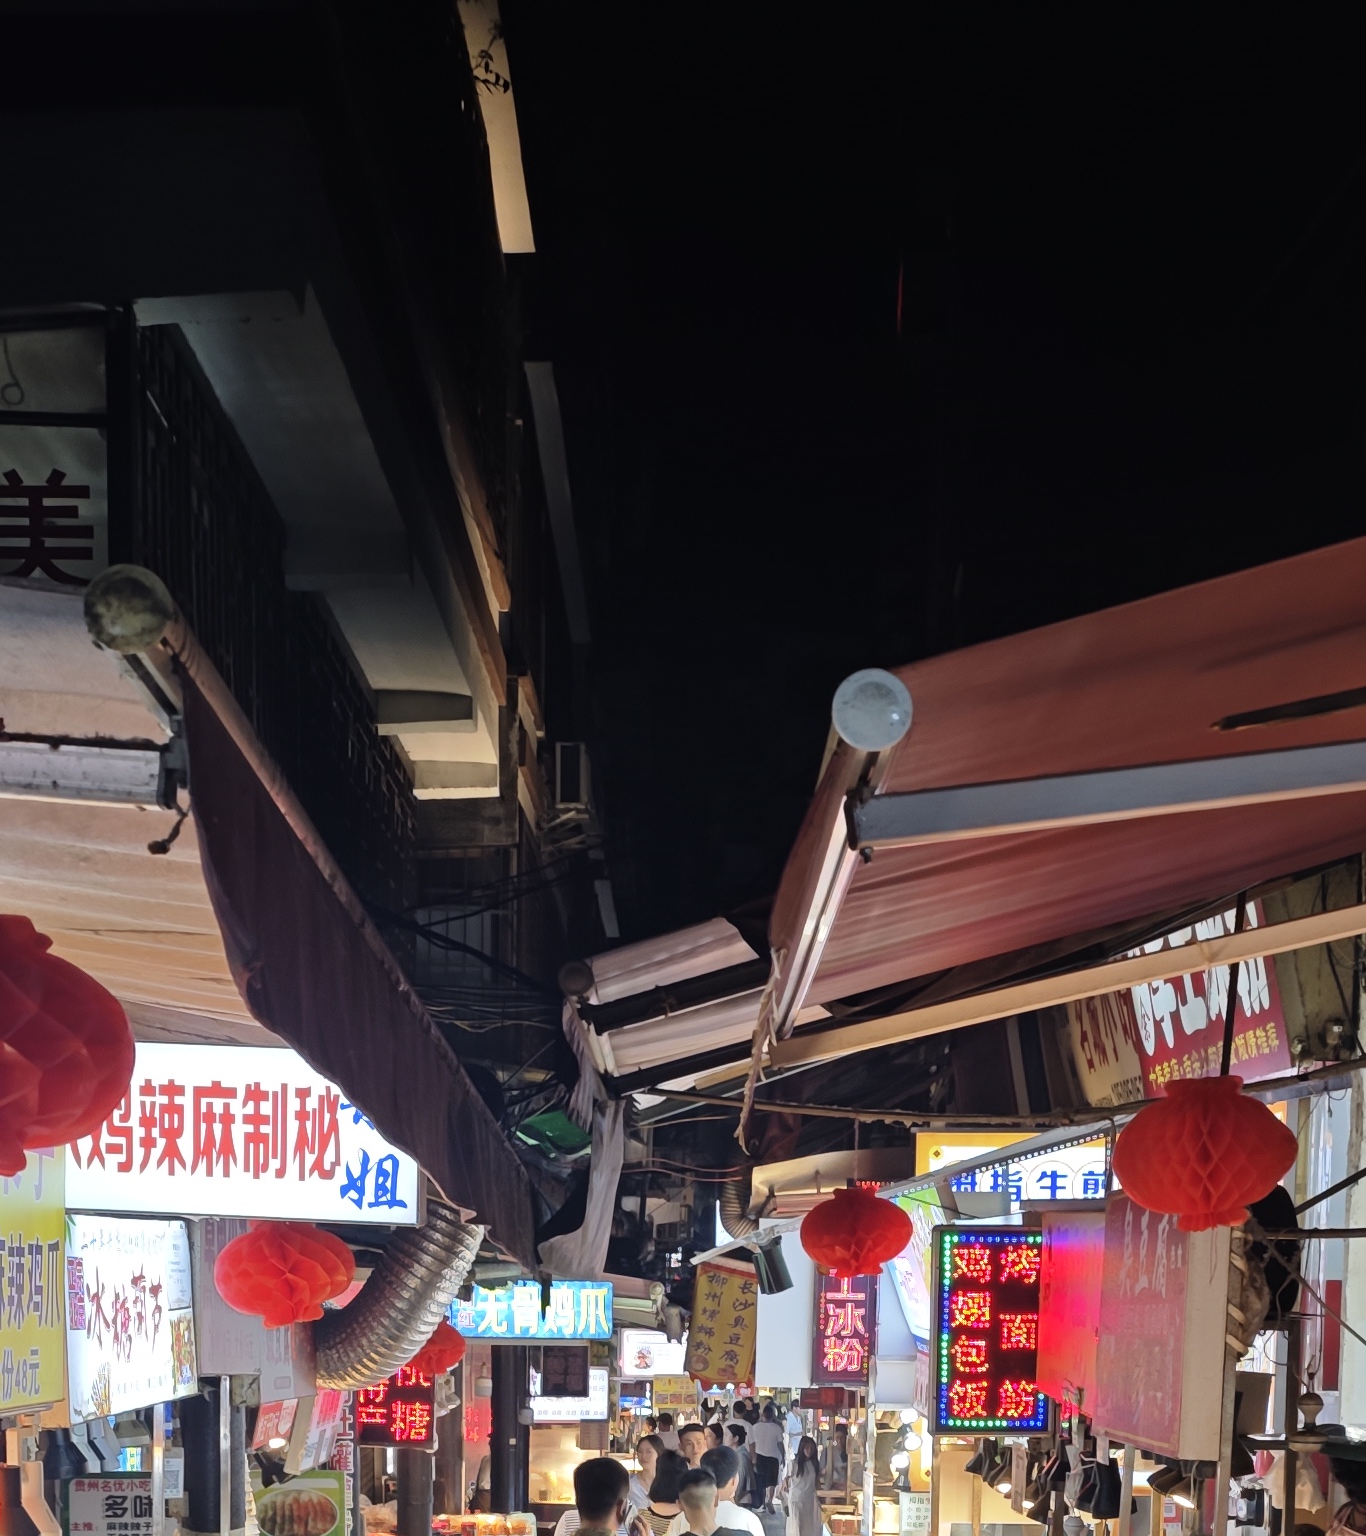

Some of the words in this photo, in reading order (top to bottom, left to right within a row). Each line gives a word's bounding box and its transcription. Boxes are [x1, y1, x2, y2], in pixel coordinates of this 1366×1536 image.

[476, 1285, 611, 1335] 无骨鸡爪
[719, 1280, 757, 1367] 长沙臭豆腐
[75, 1480, 151, 1492] 贵州名优小吃
